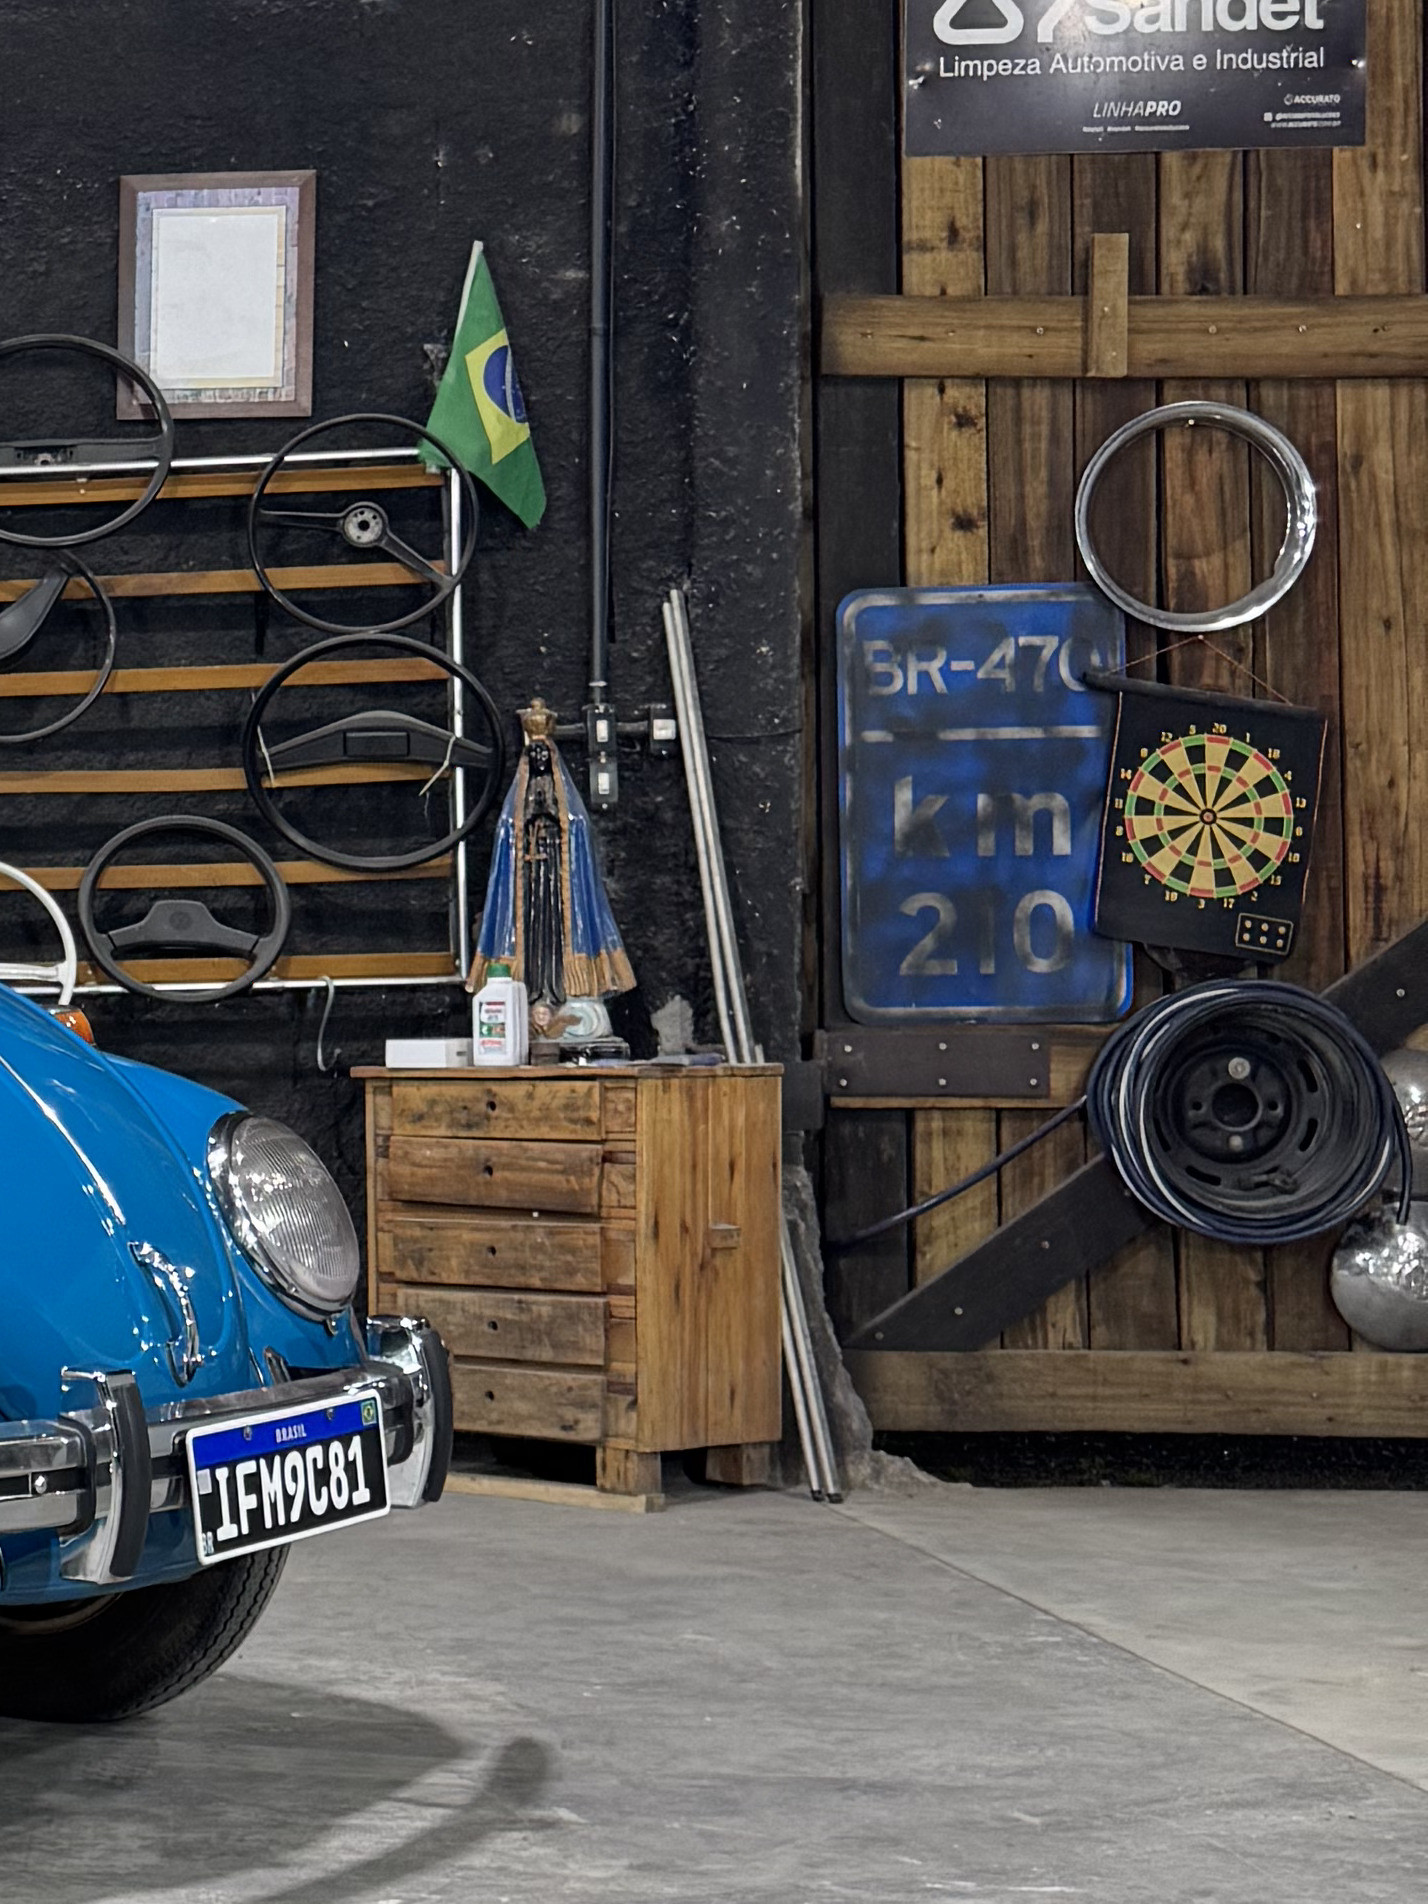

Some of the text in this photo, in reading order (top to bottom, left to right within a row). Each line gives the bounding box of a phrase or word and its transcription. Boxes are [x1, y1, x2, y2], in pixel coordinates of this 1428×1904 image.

[938, 46, 1325, 81] Limpeza Automotiva e Industrial
[894, 775, 1072, 858] km
[899, 889, 1075, 977] 210
[275, 1423, 307, 1444] BRASIL
[215, 1434, 371, 1542] IFM9C81
